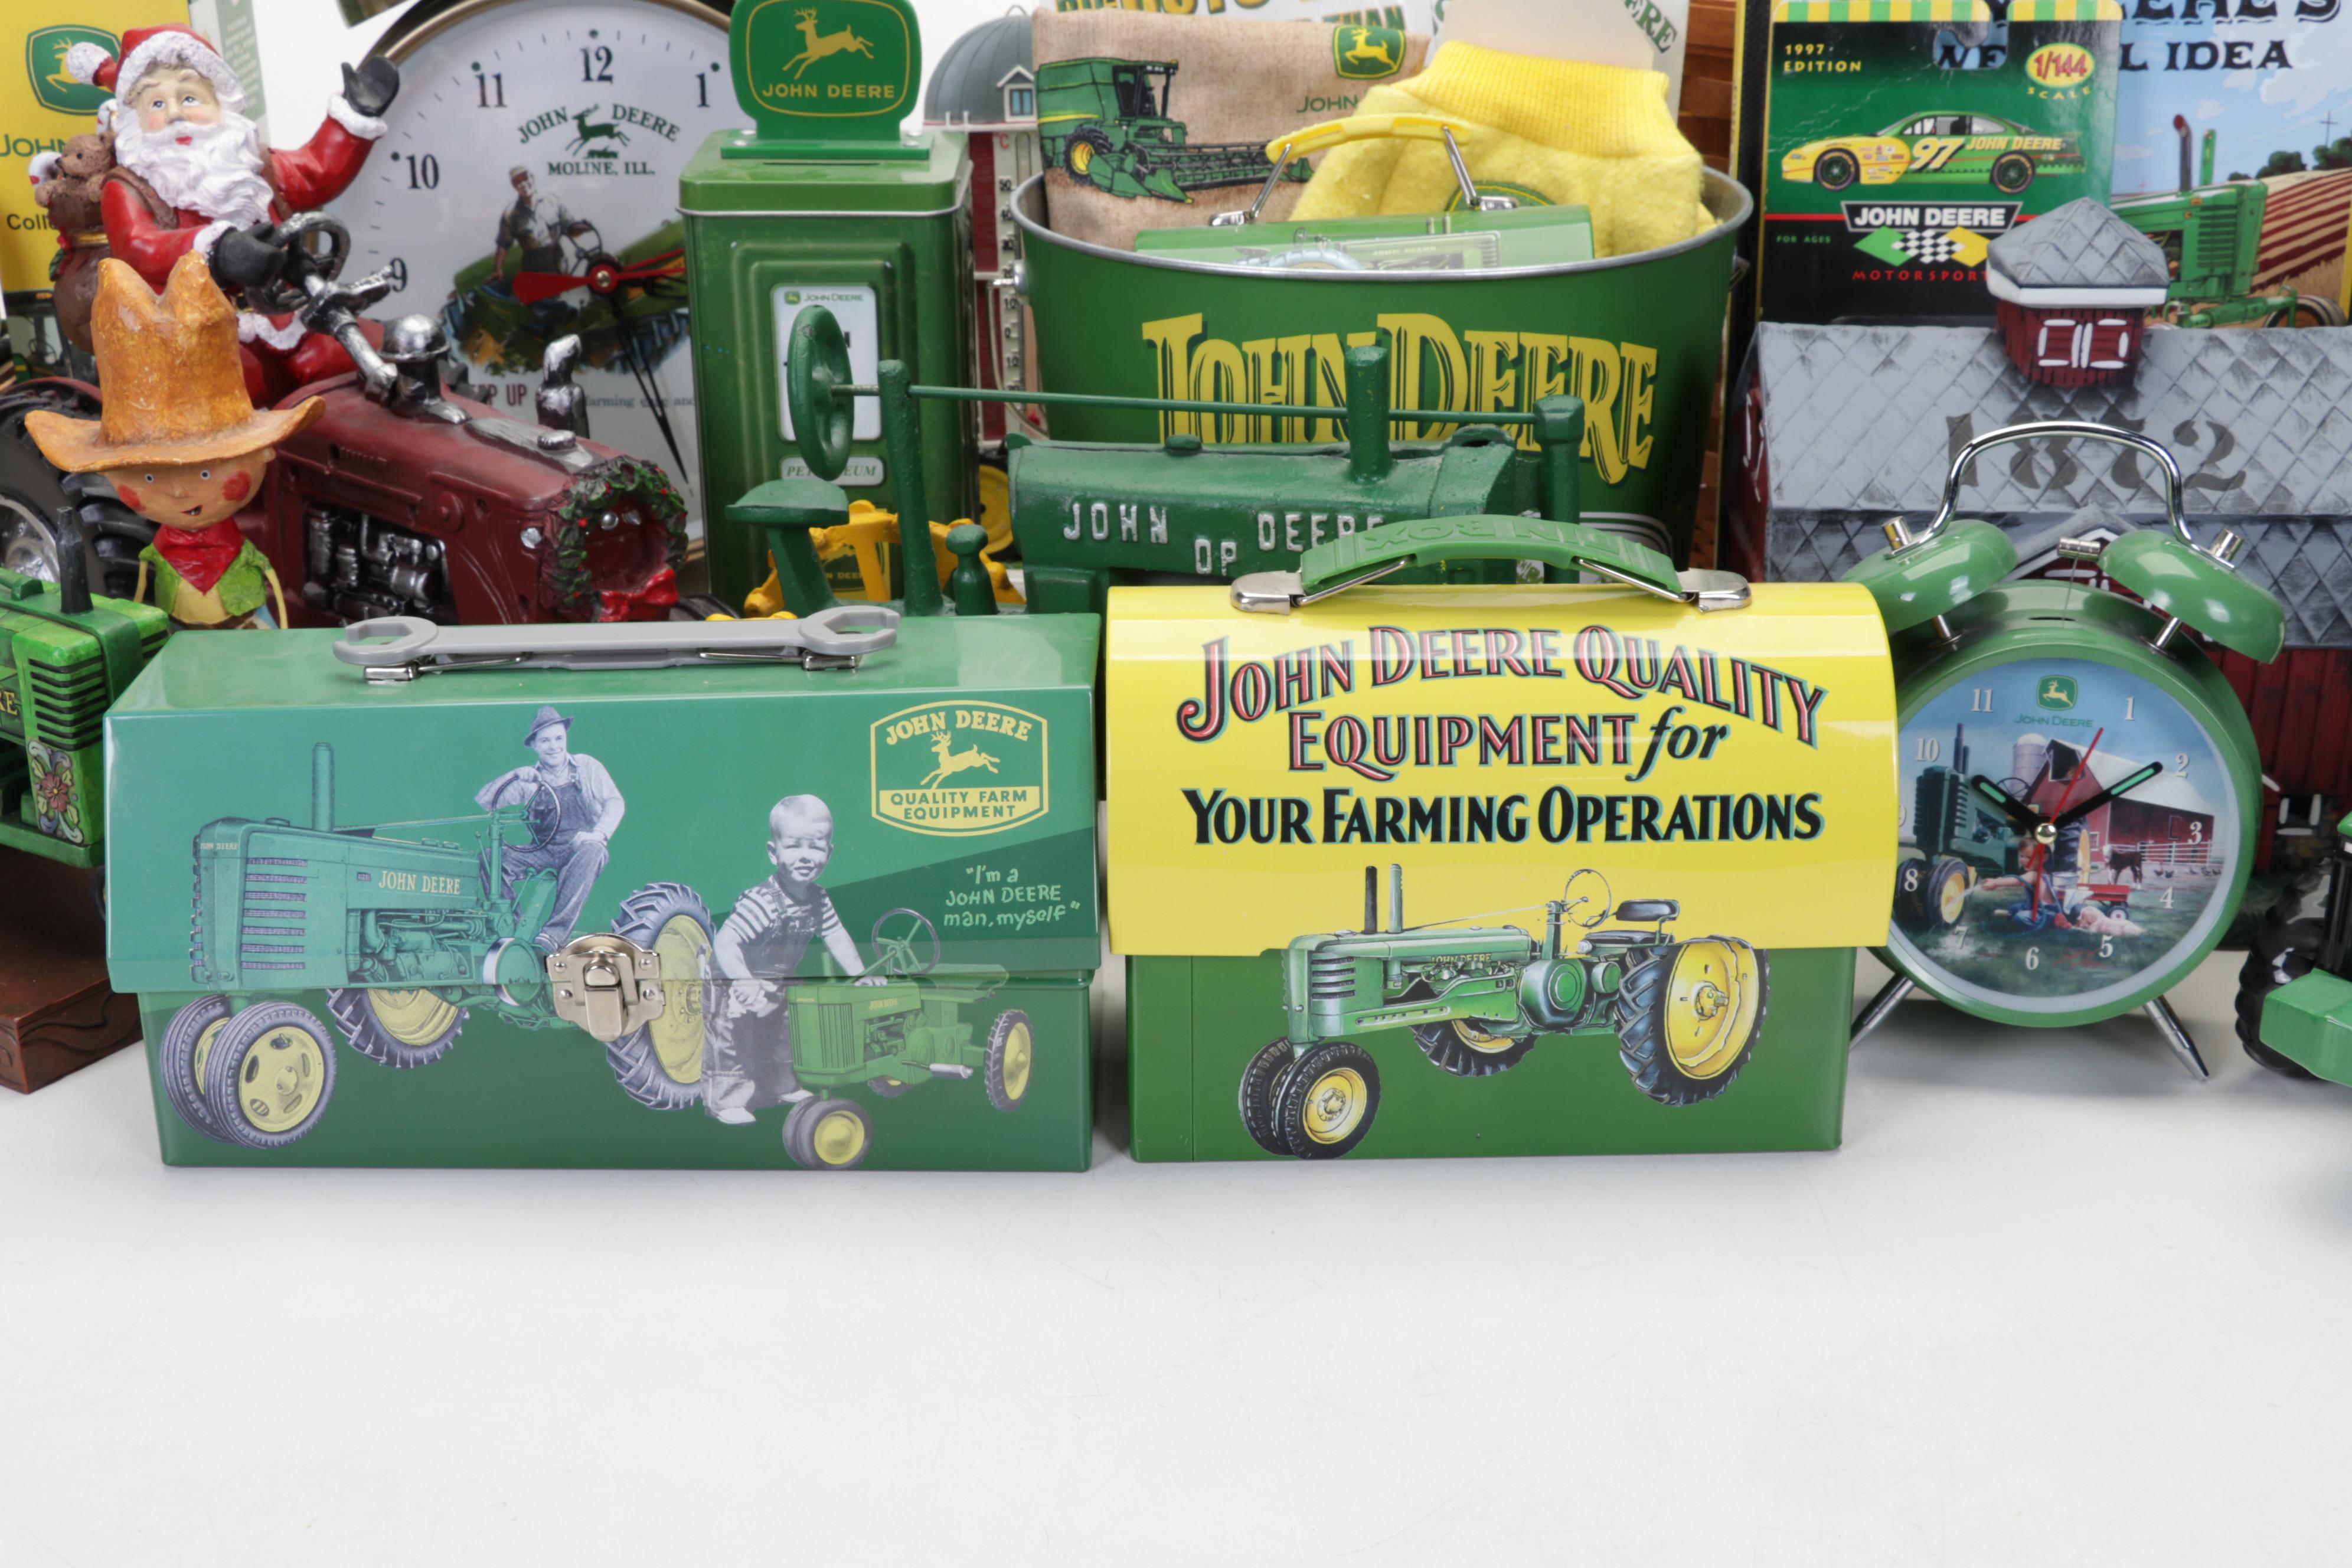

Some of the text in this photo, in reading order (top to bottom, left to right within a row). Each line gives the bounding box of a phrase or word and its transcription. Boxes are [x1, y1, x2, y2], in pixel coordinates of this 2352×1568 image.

[1784, 44, 1825, 55] 1997
[2163, 40, 2294, 71] IDEA
[580, 45, 614, 84] 12
[1783, 61, 1862, 72] EDITION
[2034, 50, 2087, 80] 1/144
[478, 73, 507, 108] 11
[697, 73, 710, 107] 1
[762, 84, 895, 99] JOHN DEERE
[2027, 86, 2091, 100] SCALE
[1296, 94, 1358, 113] JOHN
[517, 103, 681, 144] JOHN DEERE
[0, 133, 66, 157] JOH
[1908, 137, 2063, 172] 97 JOHN DEERE
[406, 154, 439, 190] 10
[547, 161, 655, 176] MOLINE, ILL.
[1854, 208, 2006, 226] JOHN DEERE
[1776, 235, 1831, 243] FOR AGES
[390, 257, 407, 293] 9
[506, 383, 527, 406] UP
[1377, 313, 1658, 485] DEERE
[1063, 503, 1168, 544] JOHN
[1176, 624, 1829, 750] JOHN DEERE QUALITY
[1971, 688, 1993, 713] 11
[2124, 697, 2135, 720] 1
[886, 709, 1033, 746] JOHN DEERE
[2014, 714, 2093, 727] JOHN DEERE
[1288, 705, 1731, 783] EQUIPMENT for
[1915, 737, 1939, 762] 10
[2175, 753, 2189, 778] 2
[890, 789, 1028, 806] QUALITY FARM
[903, 805, 1016, 821] EQUIPMENT
[1180, 784, 1825, 845] YOUR FARMING OPERATIONS
[2188, 821, 2203, 845] 3
[378, 870, 460, 895] JOHN DEERE
[1904, 868, 1919, 892] 8
[945, 885, 1061, 907] JOHN DEERE
[2160, 887, 2174, 910] 4
[944, 911, 994, 927] man,
[2025, 946, 2039, 970] 6
[2099, 935, 2113, 959] 5
